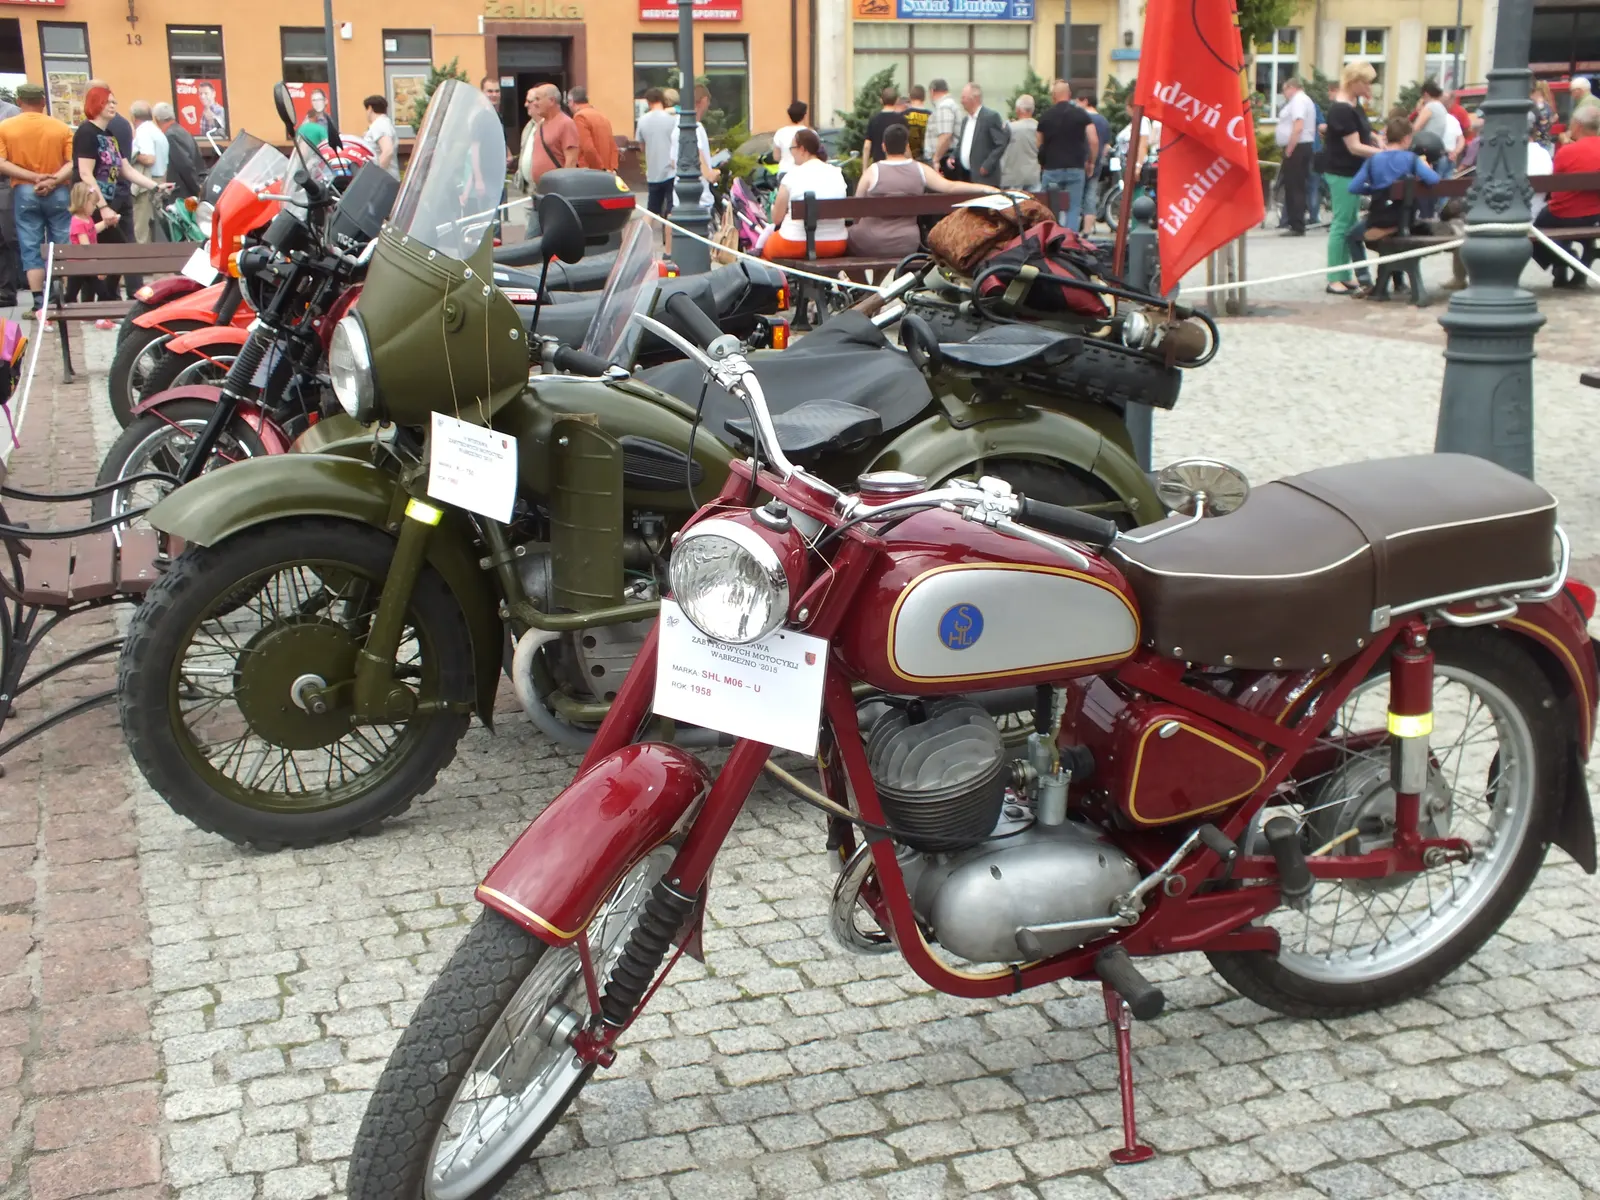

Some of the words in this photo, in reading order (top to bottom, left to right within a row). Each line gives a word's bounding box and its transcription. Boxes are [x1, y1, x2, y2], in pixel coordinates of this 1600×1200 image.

[127, 34, 142, 45] 13
[701, 669, 721, 683] SHL
[724, 675, 743, 689] M06
[754, 683, 761, 693] U
[690, 684, 712, 697] 1958
